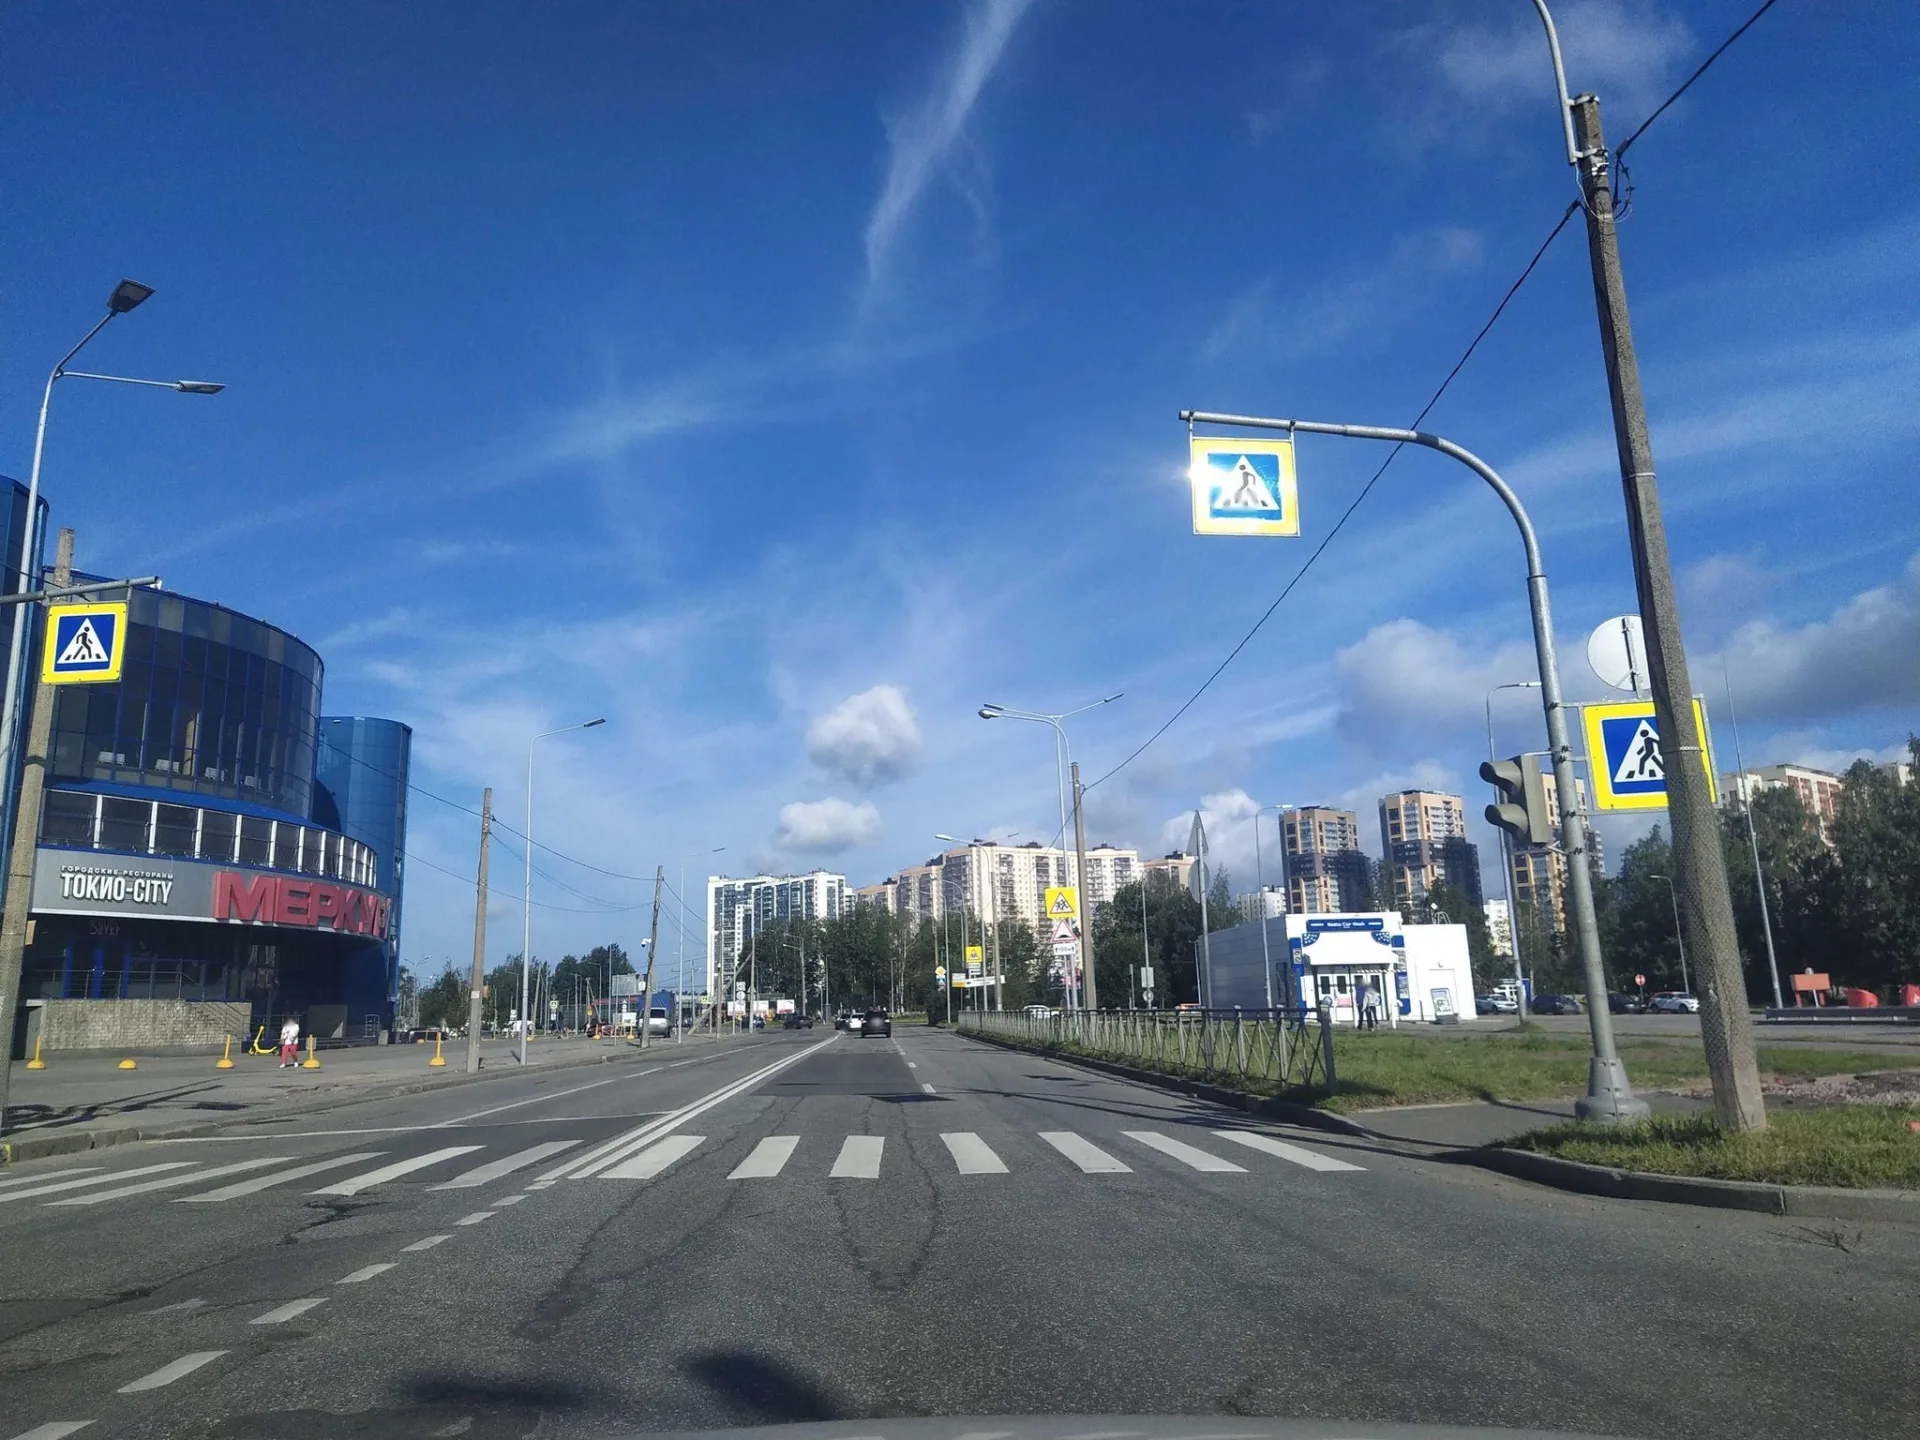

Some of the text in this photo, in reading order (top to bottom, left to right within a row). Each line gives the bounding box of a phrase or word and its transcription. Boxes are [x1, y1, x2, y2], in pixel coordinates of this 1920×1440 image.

[61, 864, 173, 879] ГОРОДСКИЕ РЕСТОРАНЫ
[61, 873, 173, 904] ТОКИО-CITY
